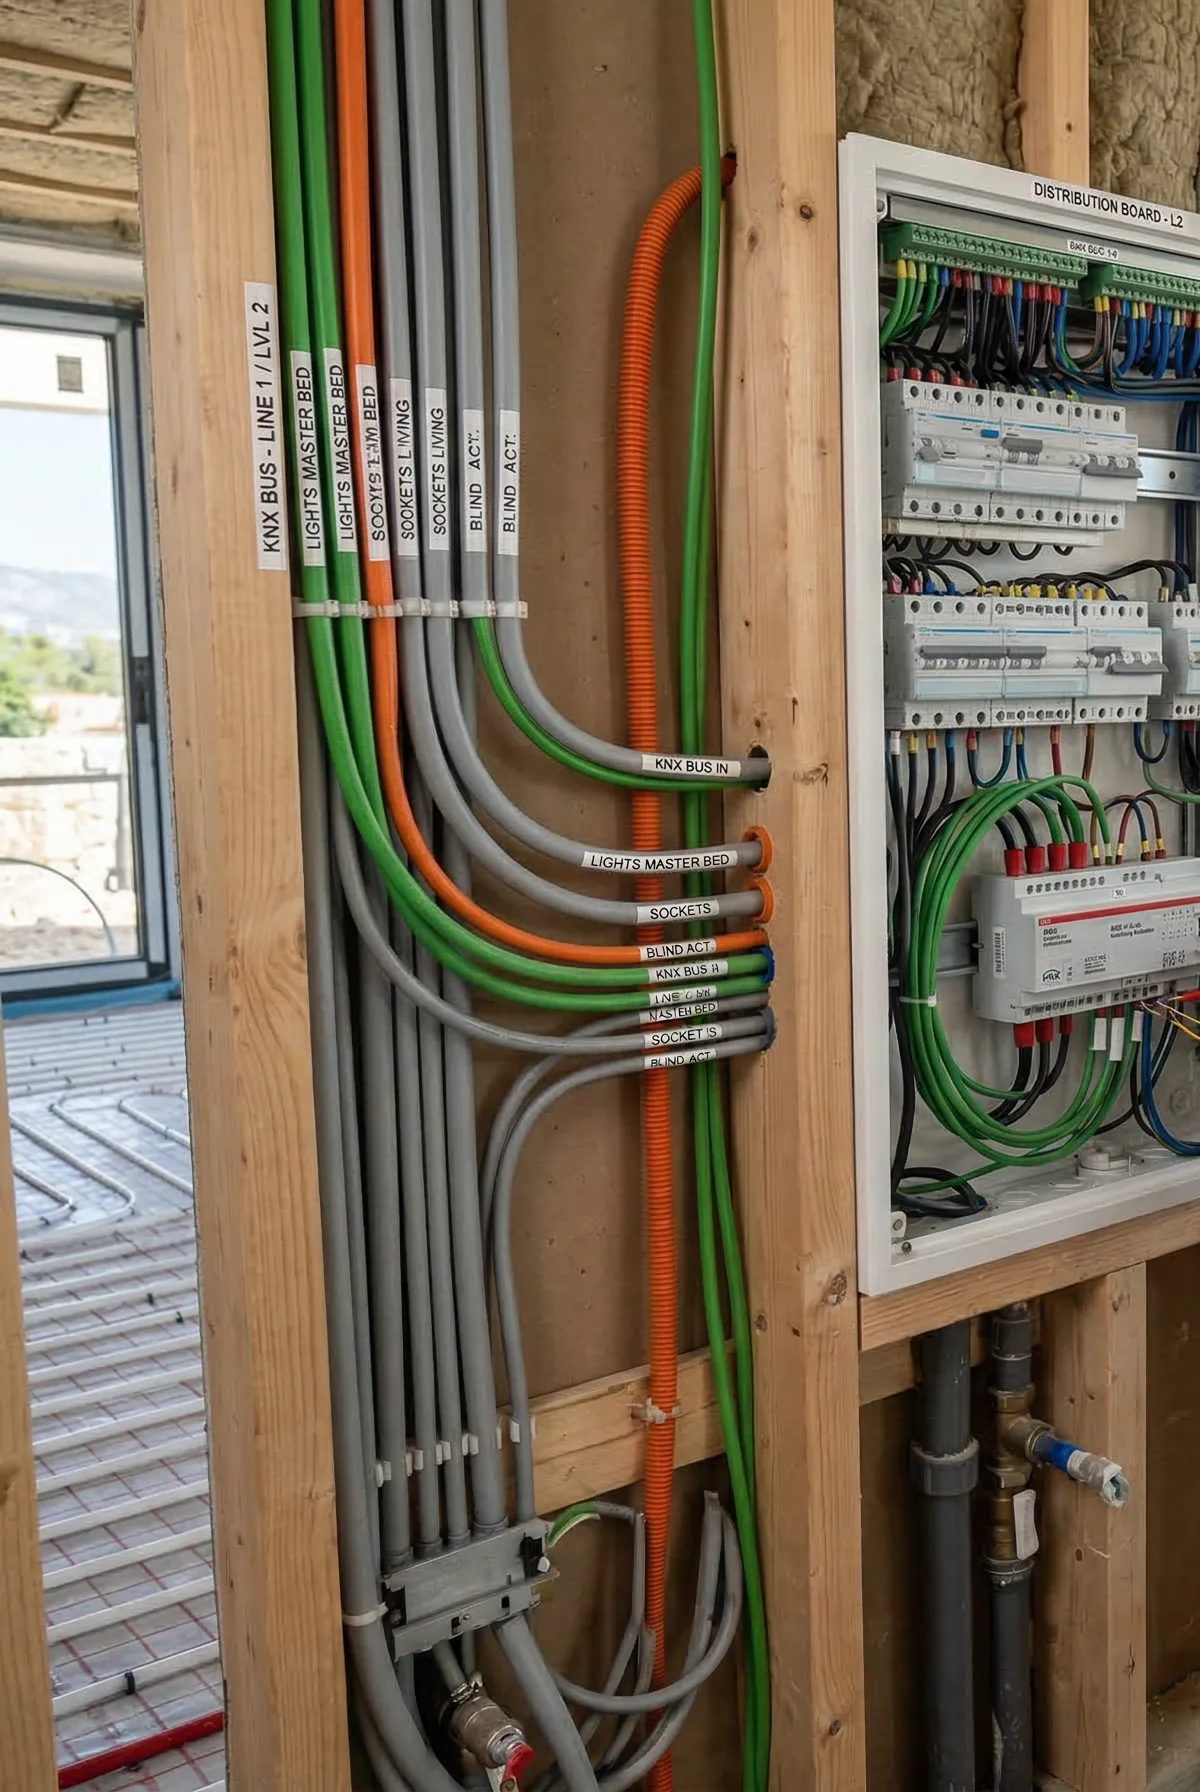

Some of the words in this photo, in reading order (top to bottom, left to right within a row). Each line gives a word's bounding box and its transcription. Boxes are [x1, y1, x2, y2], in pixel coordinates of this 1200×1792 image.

[1034, 182, 1118, 214] DISTRIBUTION
[1121, 202, 1161, 223] BOARD
[1170, 213, 1184, 228] L2
[251, 302, 269, 315] 2
[252, 321, 271, 359] LVL
[253, 363, 272, 373] /
[255, 380, 273, 388] 1
[295, 366, 312, 402] BED
[329, 364, 344, 399] BED
[256, 395, 275, 442] LINE
[431, 407, 445, 459] LIVING
[298, 407, 318, 481] MASTER
[332, 404, 350, 475] MASTER
[259, 462, 279, 504] BUS
[432, 463, 447, 536] SOCKETS
[303, 487, 321, 549] LIGHTS
[337, 481, 354, 540] LIGHTS
[469, 483, 483, 531] BLIND
[503, 485, 517, 533] BLIND
[261, 511, 281, 552] KNX
[655, 758, 683, 771] KNX
[686, 760, 712, 773] BUS
[716, 762, 729, 774] IN
[590, 855, 641, 870] LIGHTS
[644, 857, 700, 871] MASTER
[703, 854, 730, 867] BED
[650, 903, 712, 920] SOCKETS
[646, 944, 684, 959] BLIND
[655, 969, 681, 981] KNX
[684, 964, 708, 977] BUS
[650, 1055, 685, 1068] BLIND
[689, 1051, 711, 1063] ACT
